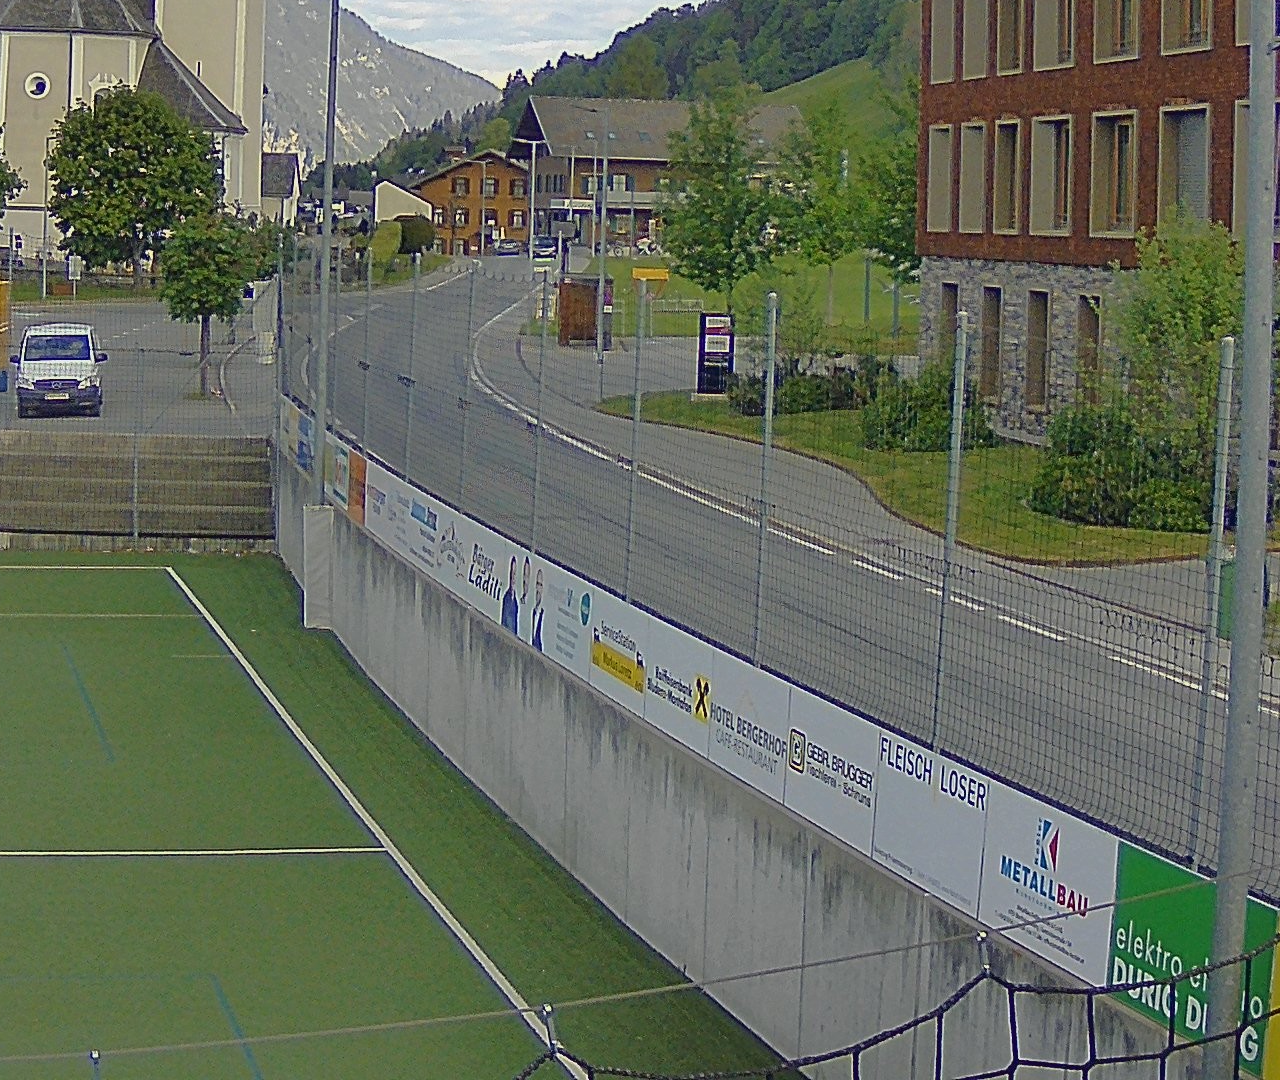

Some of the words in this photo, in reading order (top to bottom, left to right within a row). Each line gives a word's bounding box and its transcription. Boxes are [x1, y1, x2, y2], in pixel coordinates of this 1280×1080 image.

[710, 702, 735, 731] HOTEL
[736, 716, 787, 759] BERGERHOF
[832, 755, 874, 791] BRUGGER
[880, 736, 933, 785] FLEISCH
[940, 765, 987, 811] LOSER
[1000, 855, 1089, 918] METALLBAU
[1116, 920, 1183, 977] elektro
